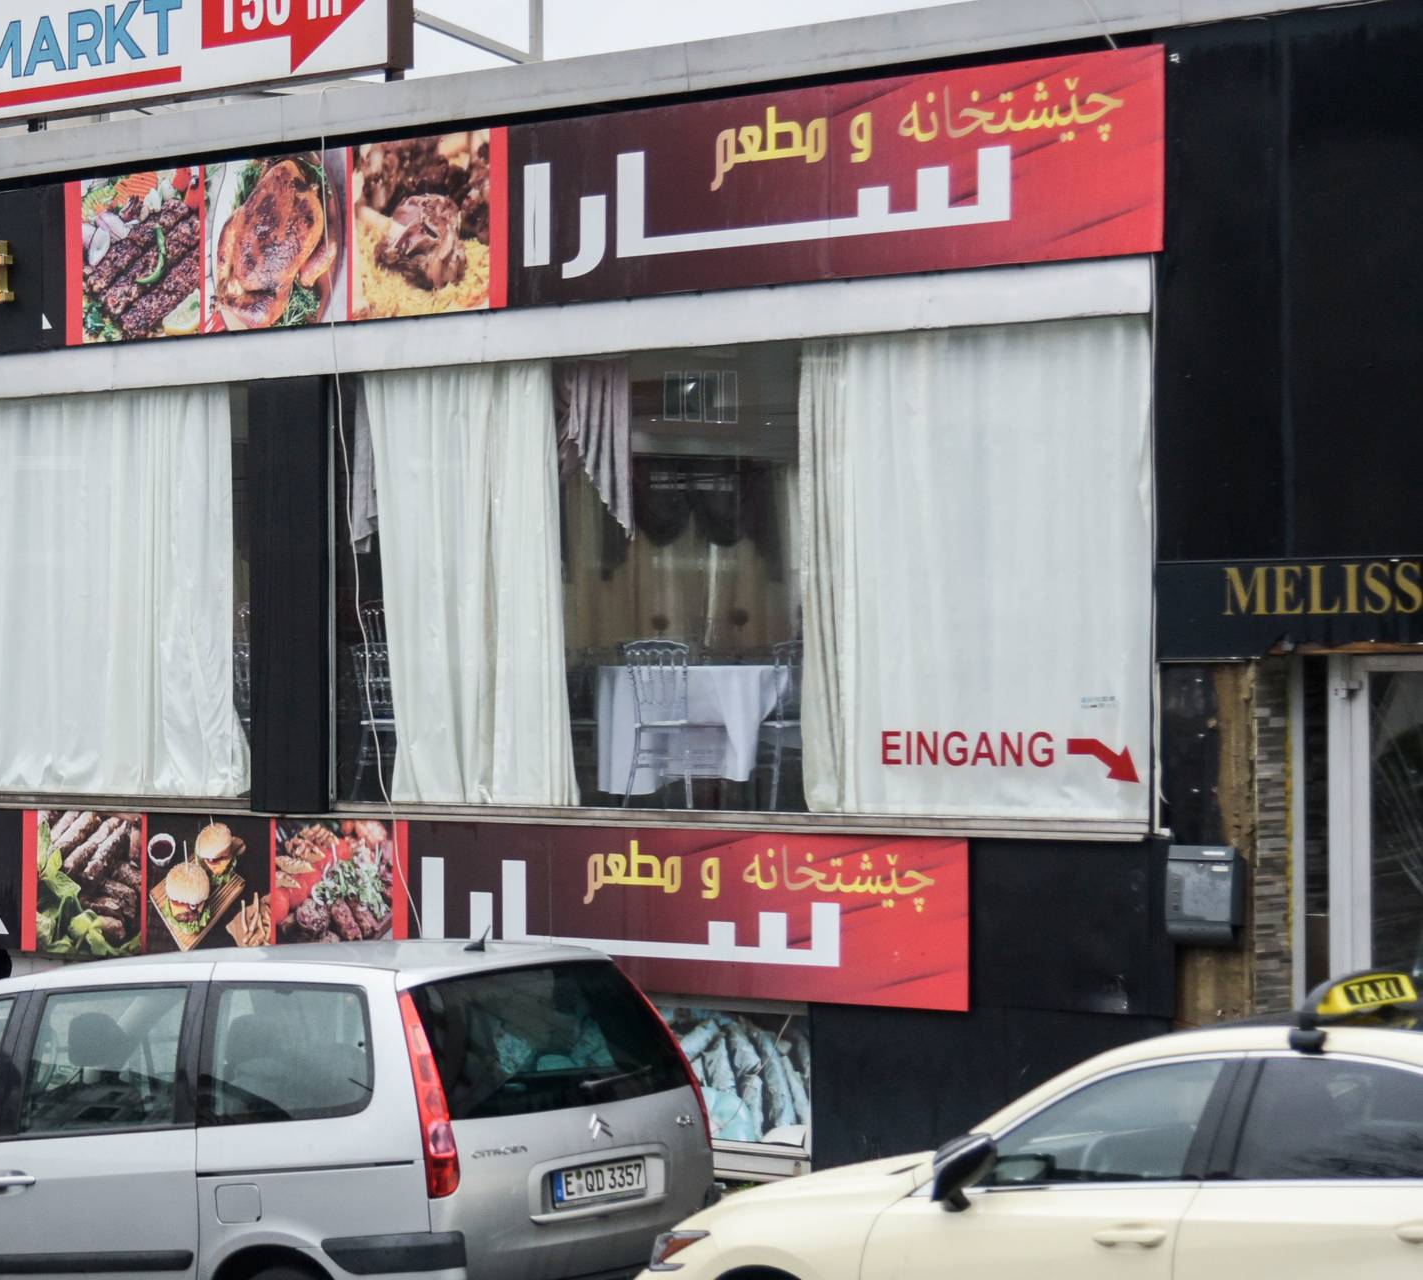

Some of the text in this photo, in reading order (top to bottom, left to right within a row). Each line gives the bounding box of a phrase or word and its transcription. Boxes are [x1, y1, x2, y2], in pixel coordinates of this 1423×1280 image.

[710, 106, 827, 191] مطعم
[849, 112, 872, 163] و
[523, 145, 1012, 279] سارا
[881, 731, 1055, 767] EINGANG
[583, 840, 682, 904] مطعم
[701, 857, 721, 899] و
[1349, 980, 1401, 1004] TAXI
[564, 1163, 643, 1196] E QD 3357
